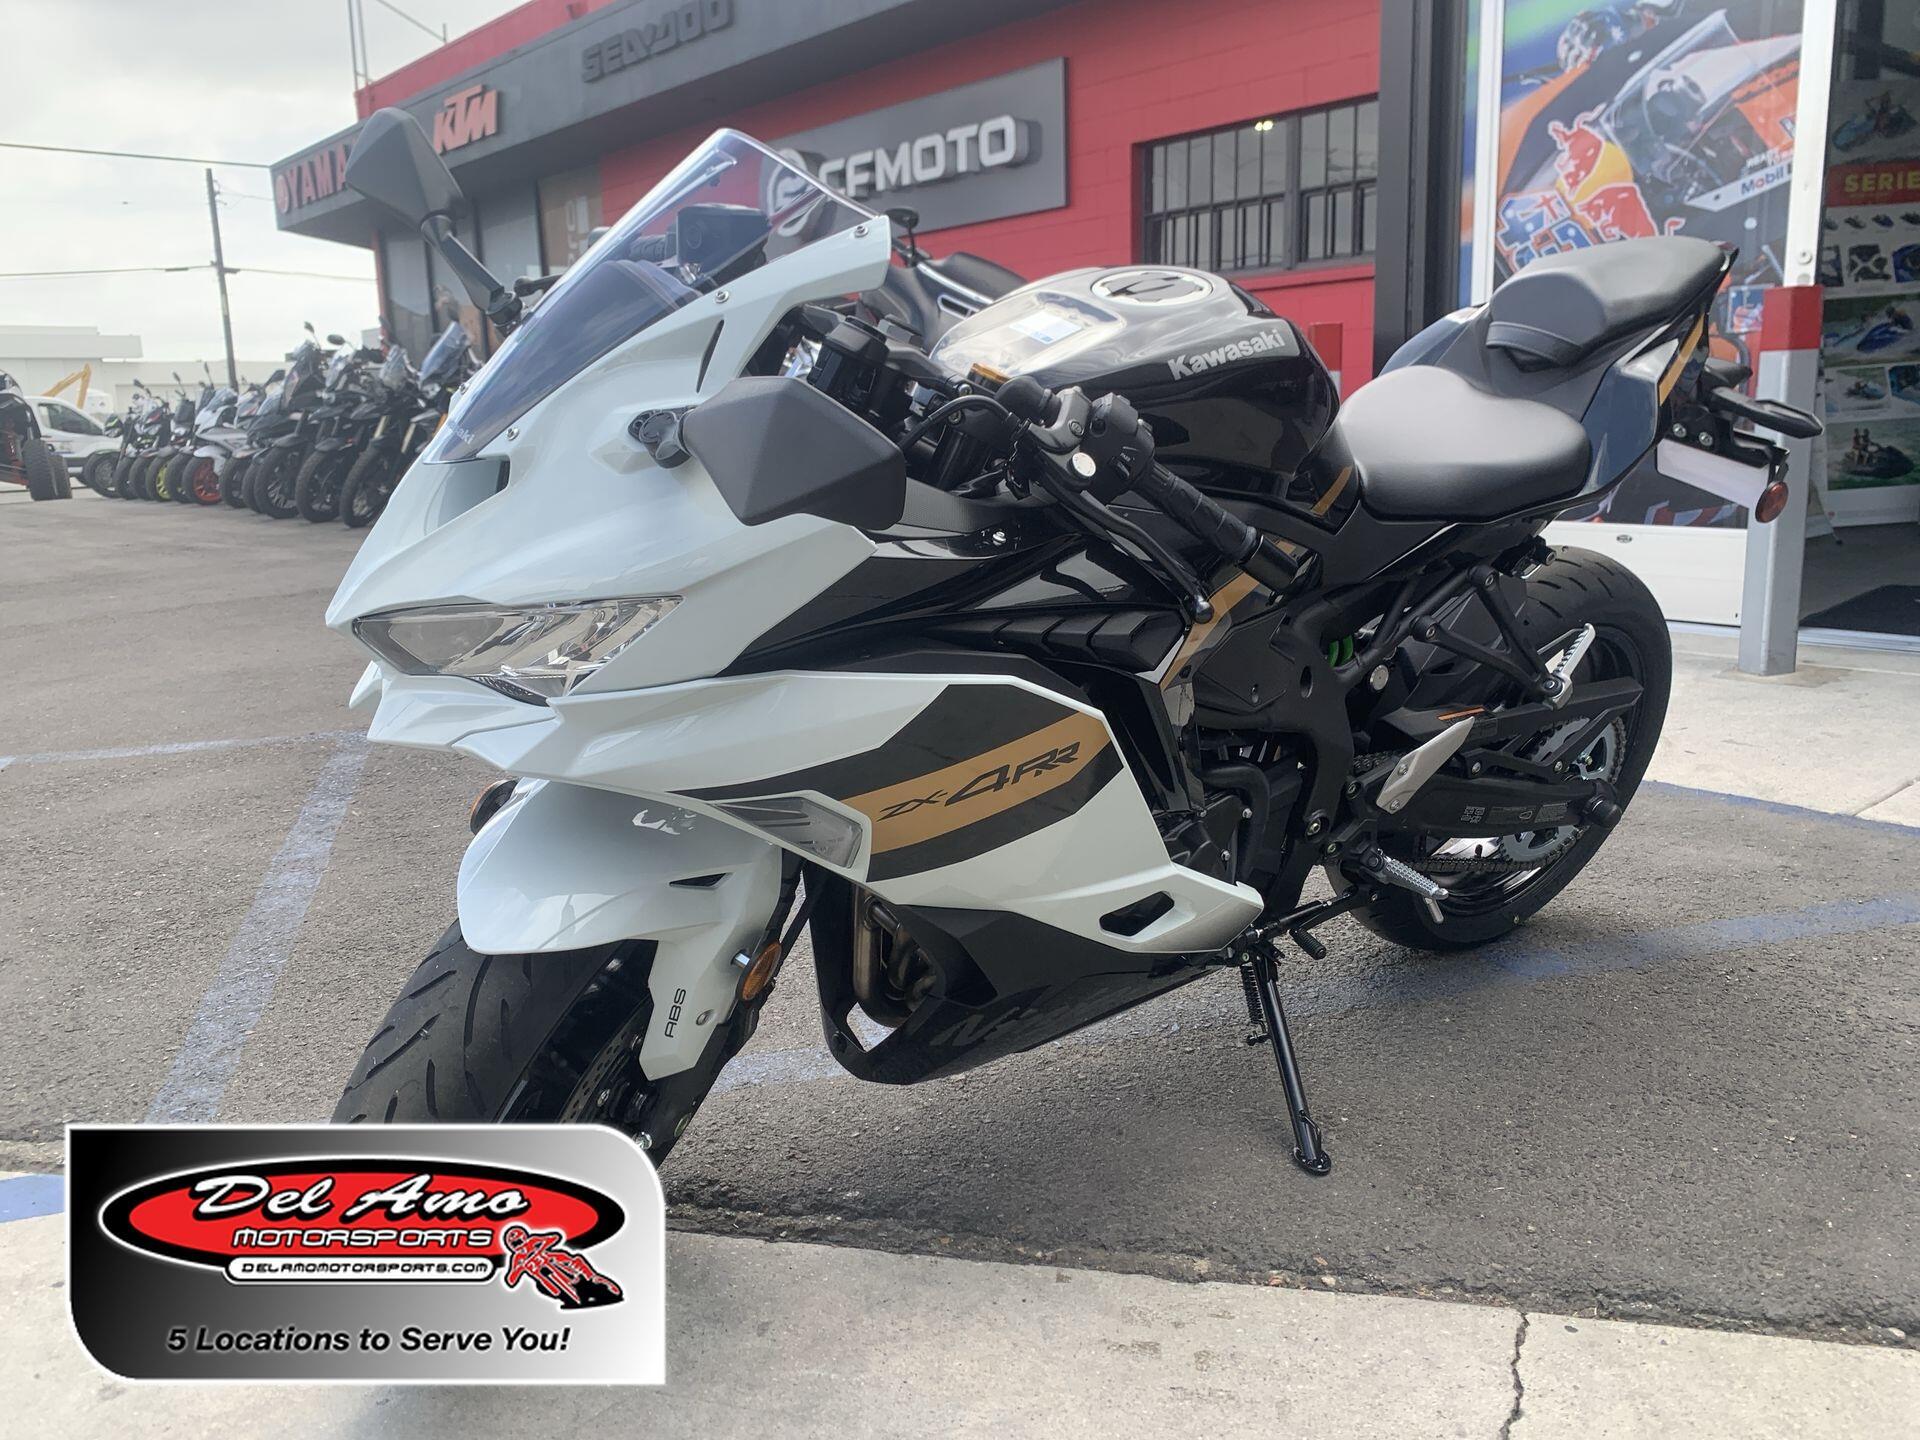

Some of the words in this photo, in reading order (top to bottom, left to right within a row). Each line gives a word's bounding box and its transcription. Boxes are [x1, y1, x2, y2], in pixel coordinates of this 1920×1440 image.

[433, 84, 498, 155] KTM
[286, 139, 357, 209] YAMA
[818, 114, 1018, 201] CFMOTO
[1741, 165, 1784, 195] Mobil
[1167, 328, 1286, 381] Kawasaki
[664, 988, 686, 1038] ABS
